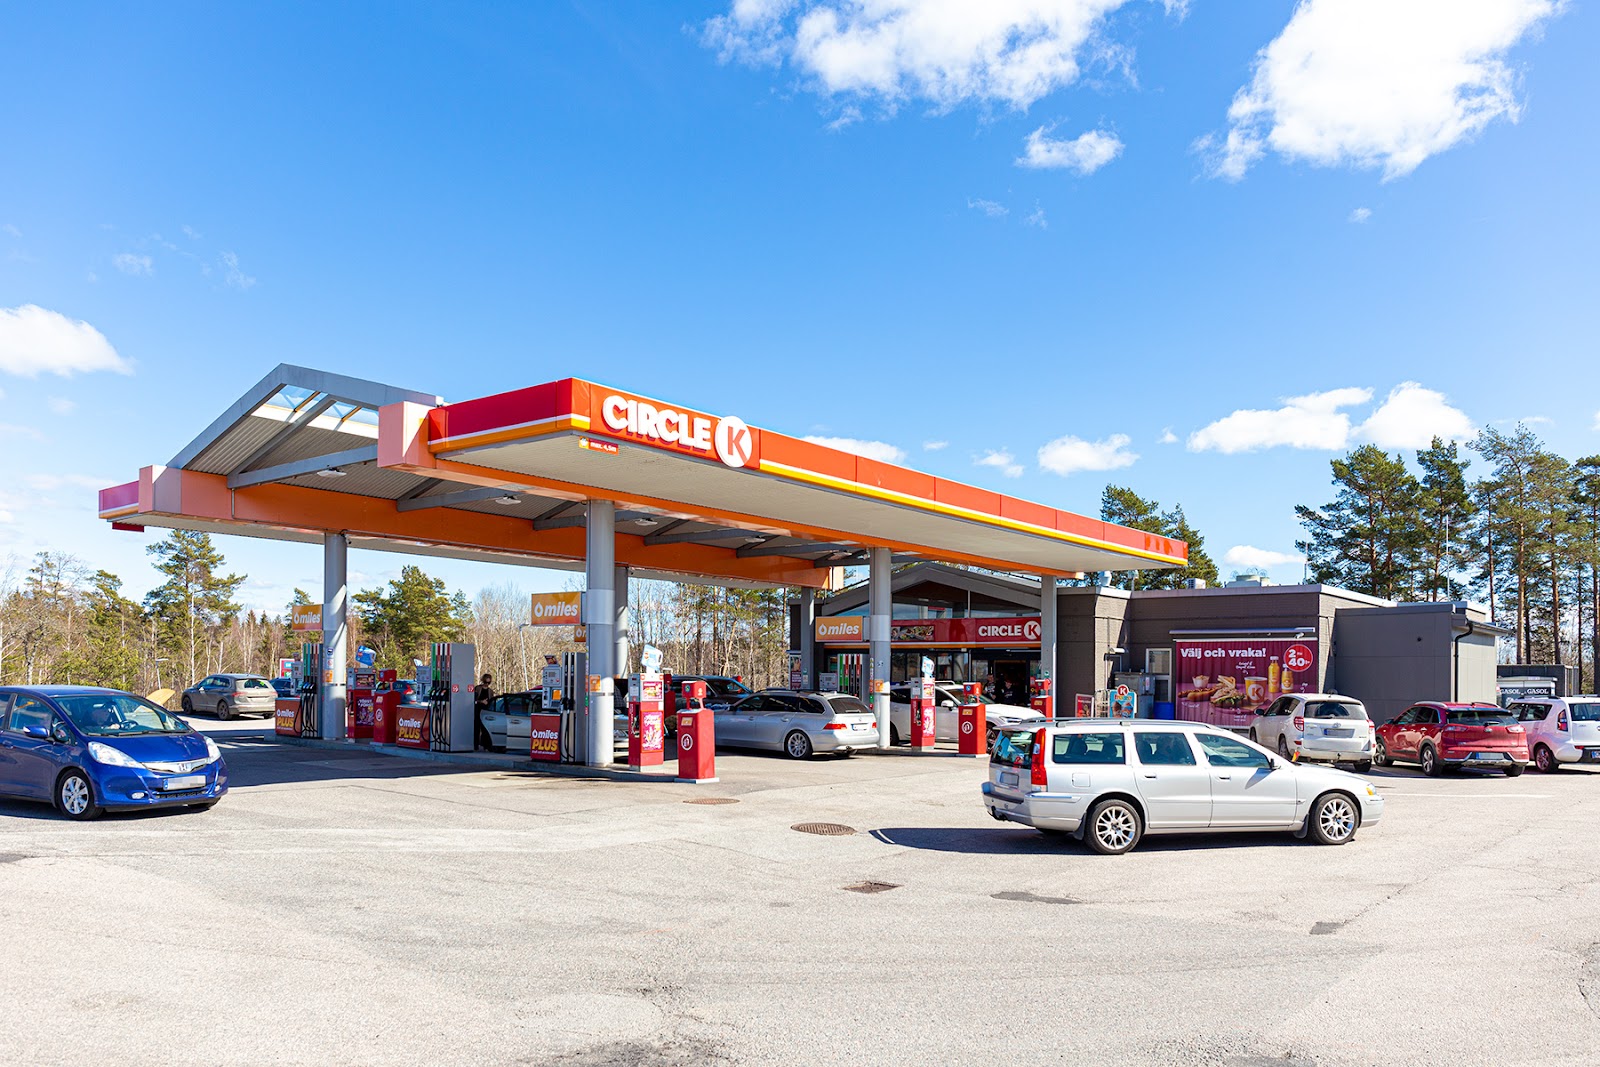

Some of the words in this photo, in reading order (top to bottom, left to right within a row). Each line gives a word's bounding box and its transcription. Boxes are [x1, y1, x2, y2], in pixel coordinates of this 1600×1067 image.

[602, 395, 712, 451] CIRCLE
[544, 601, 578, 617] miles
[300, 612, 320, 623] miles
[827, 623, 859, 635] miles
[978, 625, 1022, 637] CIRCLE
[1180, 648, 1201, 659] Välj
[1204, 648, 1225, 658] och
[1228, 648, 1266, 658] vraka!
[1288, 649, 1296, 658] 2
[276, 717, 294, 727] PLUS
[403, 718, 421, 728] miles
[399, 727, 420, 739] PLUS
[538, 730, 558, 739] miles
[532, 739, 558, 751] PLUS
